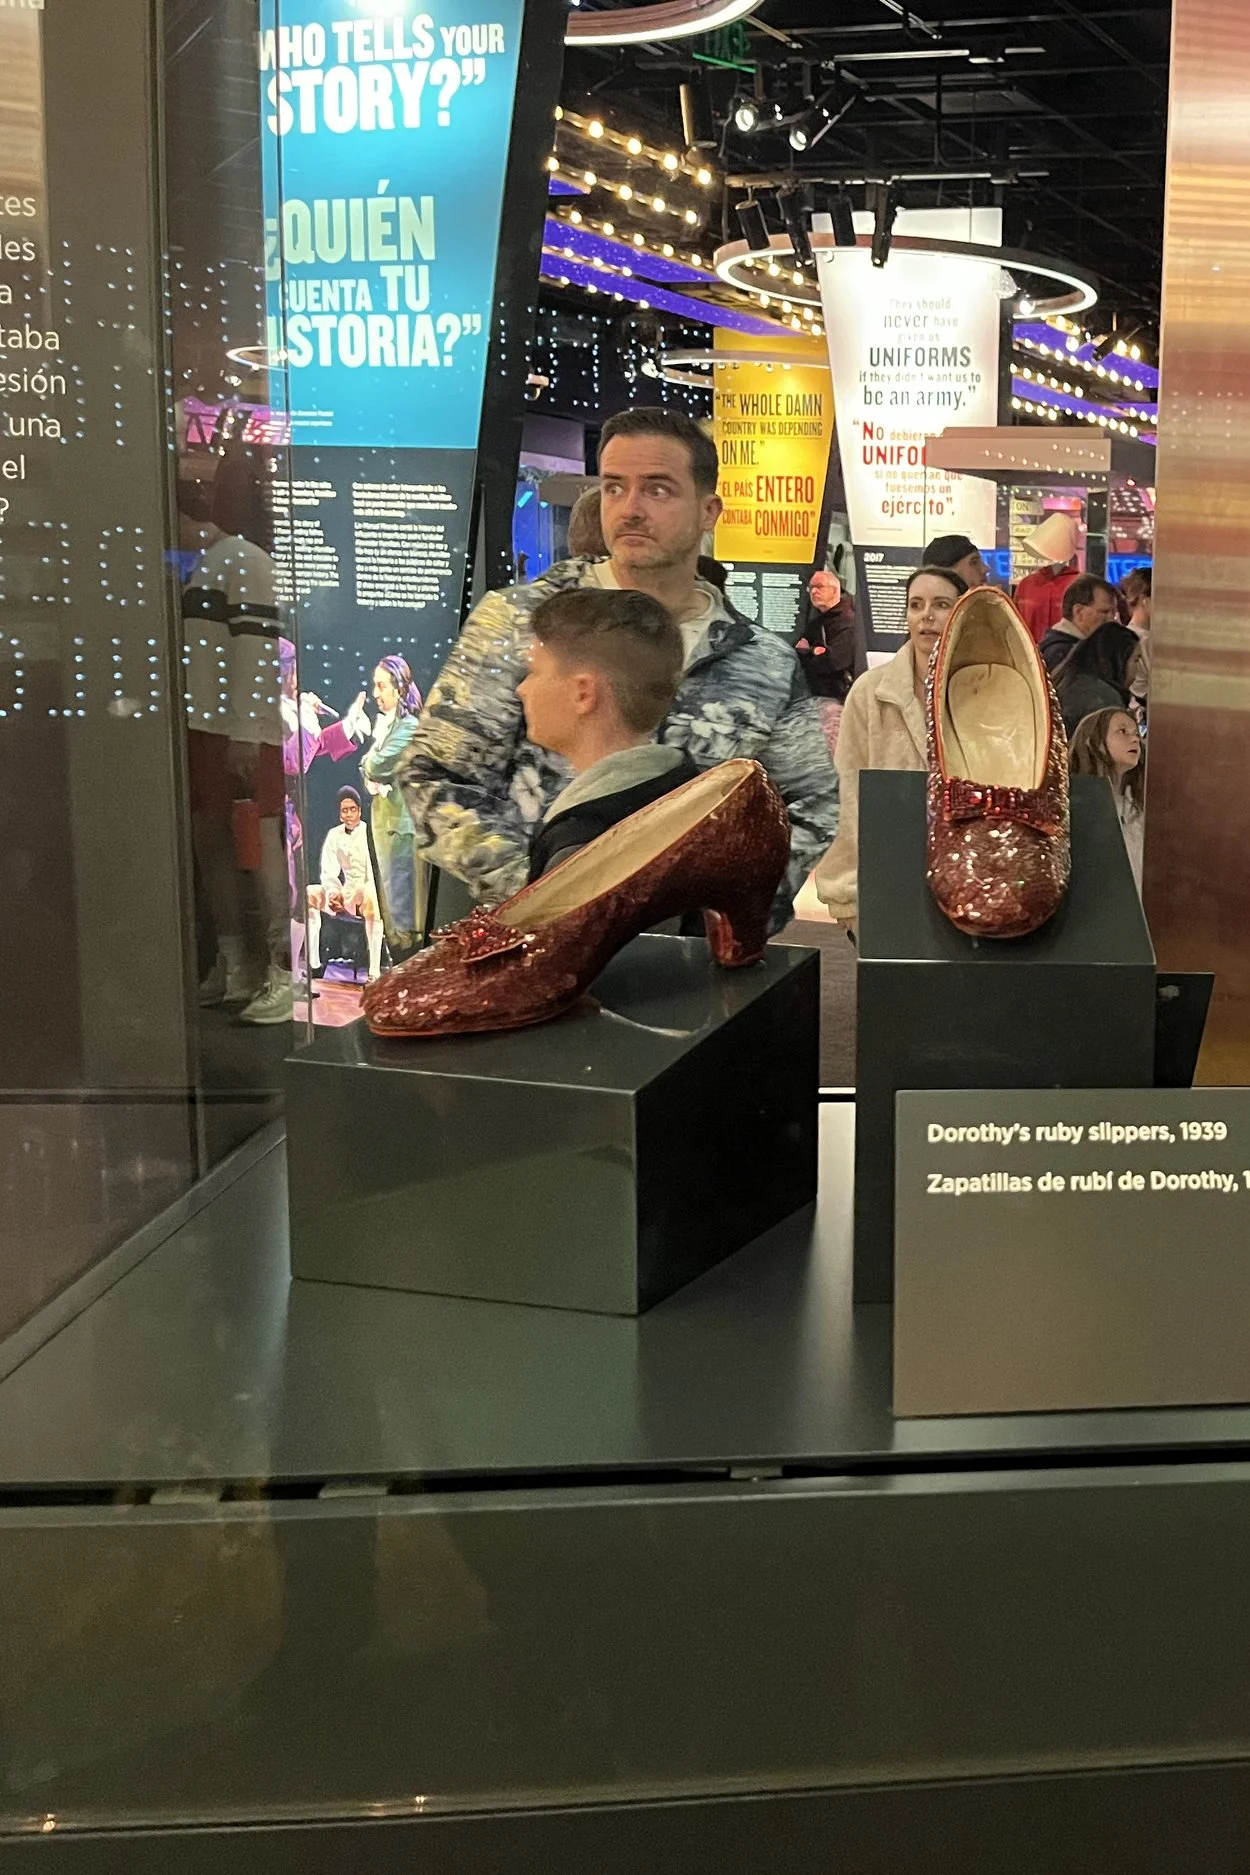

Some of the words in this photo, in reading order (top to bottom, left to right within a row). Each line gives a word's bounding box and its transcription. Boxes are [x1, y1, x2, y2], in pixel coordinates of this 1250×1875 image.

[331, 13, 436, 64] TELLS
[439, 23, 506, 57] YOUR
[266, 57, 487, 137] STORY?”
[379, 265, 430, 312] TU
[883, 315, 930, 329] never
[869, 346, 972, 368] UNIFORMS
[869, 371, 892, 385] they
[955, 372, 968, 383] us
[970, 372, 982, 383] to
[740, 394, 782, 416] WHOLE
[785, 394, 823, 417] DAMN
[863, 385, 884, 406] be
[889, 390, 911, 406] an
[9, 416, 61, 438] una
[722, 421, 757, 436] COUNTRY
[760, 421, 777, 436] WAS
[778, 421, 823, 436] DEPENDING
[722, 440, 738, 466] ON
[2, 454, 25, 480] el
[734, 479, 754, 498] PAÍS
[756, 475, 815, 503] ENTERO
[722, 509, 752, 525] CONTABA
[1035, 1121, 1084, 1145] ruby
[1088, 1120, 1176, 1144] slippers,
[1179, 1120, 1228, 1141] 1939
[926, 1172, 1033, 1196] Zapatillas
[1037, 1171, 1066, 1192] de
[1070, 1170, 1114, 1191] rubí
[1117, 1170, 1146, 1191] de
[1149, 1169, 1239, 1193] Dorothy,
